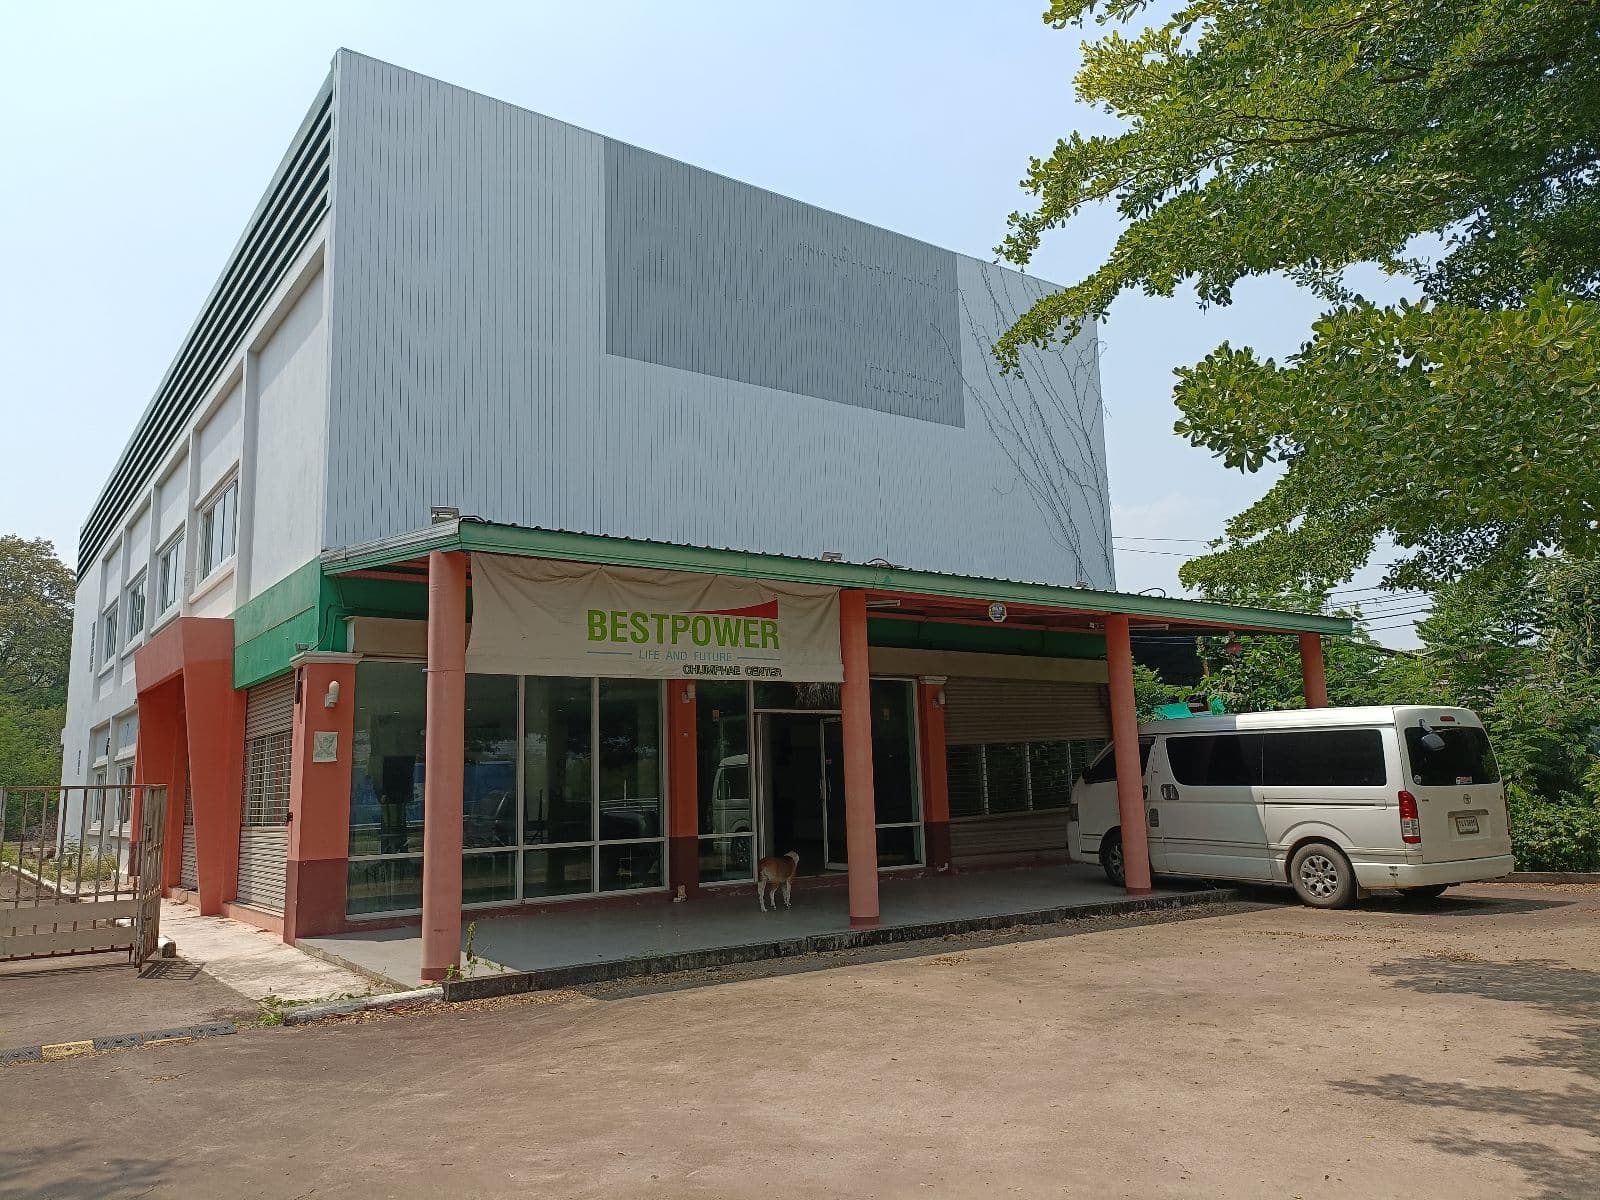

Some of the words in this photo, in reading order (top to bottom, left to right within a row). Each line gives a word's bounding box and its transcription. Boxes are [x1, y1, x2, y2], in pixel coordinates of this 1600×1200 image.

[587, 609, 780, 649] BESTPOWER
[639, 648, 660, 660] LIFE
[666, 650, 688, 661] AND
[695, 651, 733, 662] FUTURE
[682, 663, 741, 676] CHUMPHAE
[744, 665, 782, 677] CENTER
